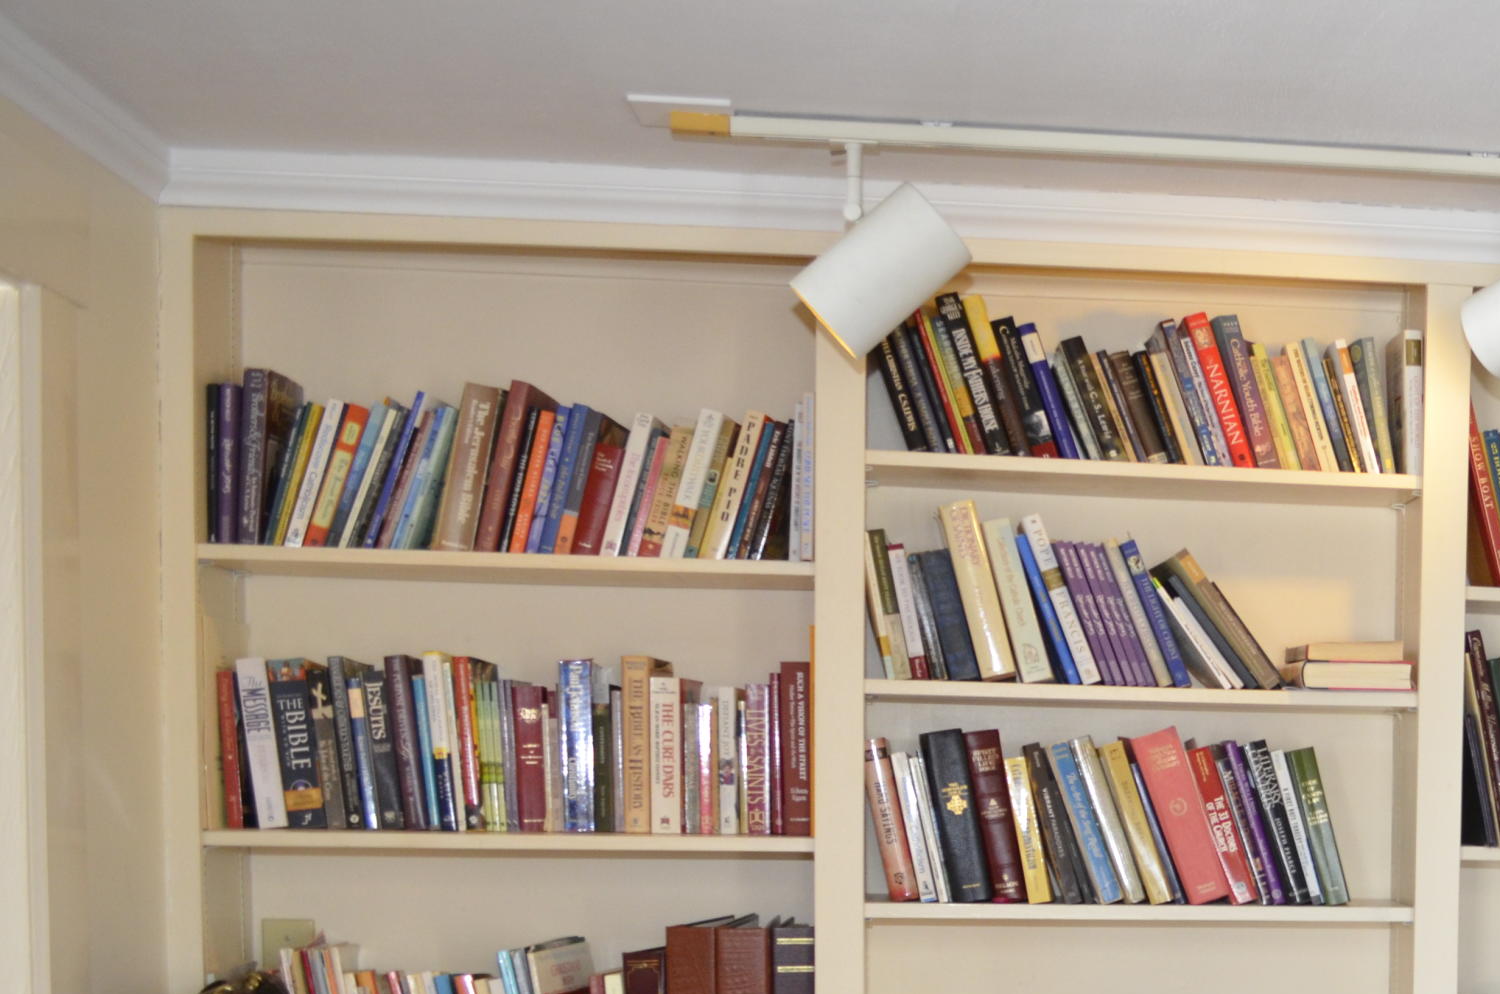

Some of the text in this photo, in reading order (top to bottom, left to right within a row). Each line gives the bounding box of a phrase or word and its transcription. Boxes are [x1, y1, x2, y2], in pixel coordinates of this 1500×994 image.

[952, 328, 999, 433] INSIDE MY HOUSE
[1207, 363, 1244, 445] NARNIAN
[1230, 339, 1264, 437] Catholic Youth Bible
[1097, 414, 1112, 439] Lewis
[458, 402, 491, 524] The Jerusalem Bible
[658, 435, 688, 526] WALKING THE BIBLE
[721, 422, 755, 521] PADRE PIO
[1471, 437, 1495, 510] SHOW BOAT
[1033, 528, 1086, 652] POPE FRANCIS
[1160, 630, 1177, 660] CHRIST
[277, 698, 304, 710] THE
[796, 672, 805, 692] SUCH
[242, 688, 272, 734] MESSAGE
[365, 683, 387, 740] JESUITS
[662, 703, 674, 726] THE
[797, 701, 805, 726] VISION
[285, 710, 312, 770] BIBLE
[629, 679, 644, 809] THE BIBLE AS HISTORY
[747, 710, 765, 804] LIVES SAINTS
[798, 739, 806, 752] THE
[798, 755, 806, 781] STREET
[1260, 747, 1282, 805] LITERARY
[880, 807, 896, 845] SAYINGS
[1042, 787, 1064, 858] VIBRANT PARADOXES
[1208, 812, 1219, 825] THE
[1212, 824, 1227, 853] CHURCH
[1213, 795, 1224, 809] THE
[1222, 820, 1237, 853] DOCTORS
[1274, 817, 1296, 874] JOSEPH PEARCE
